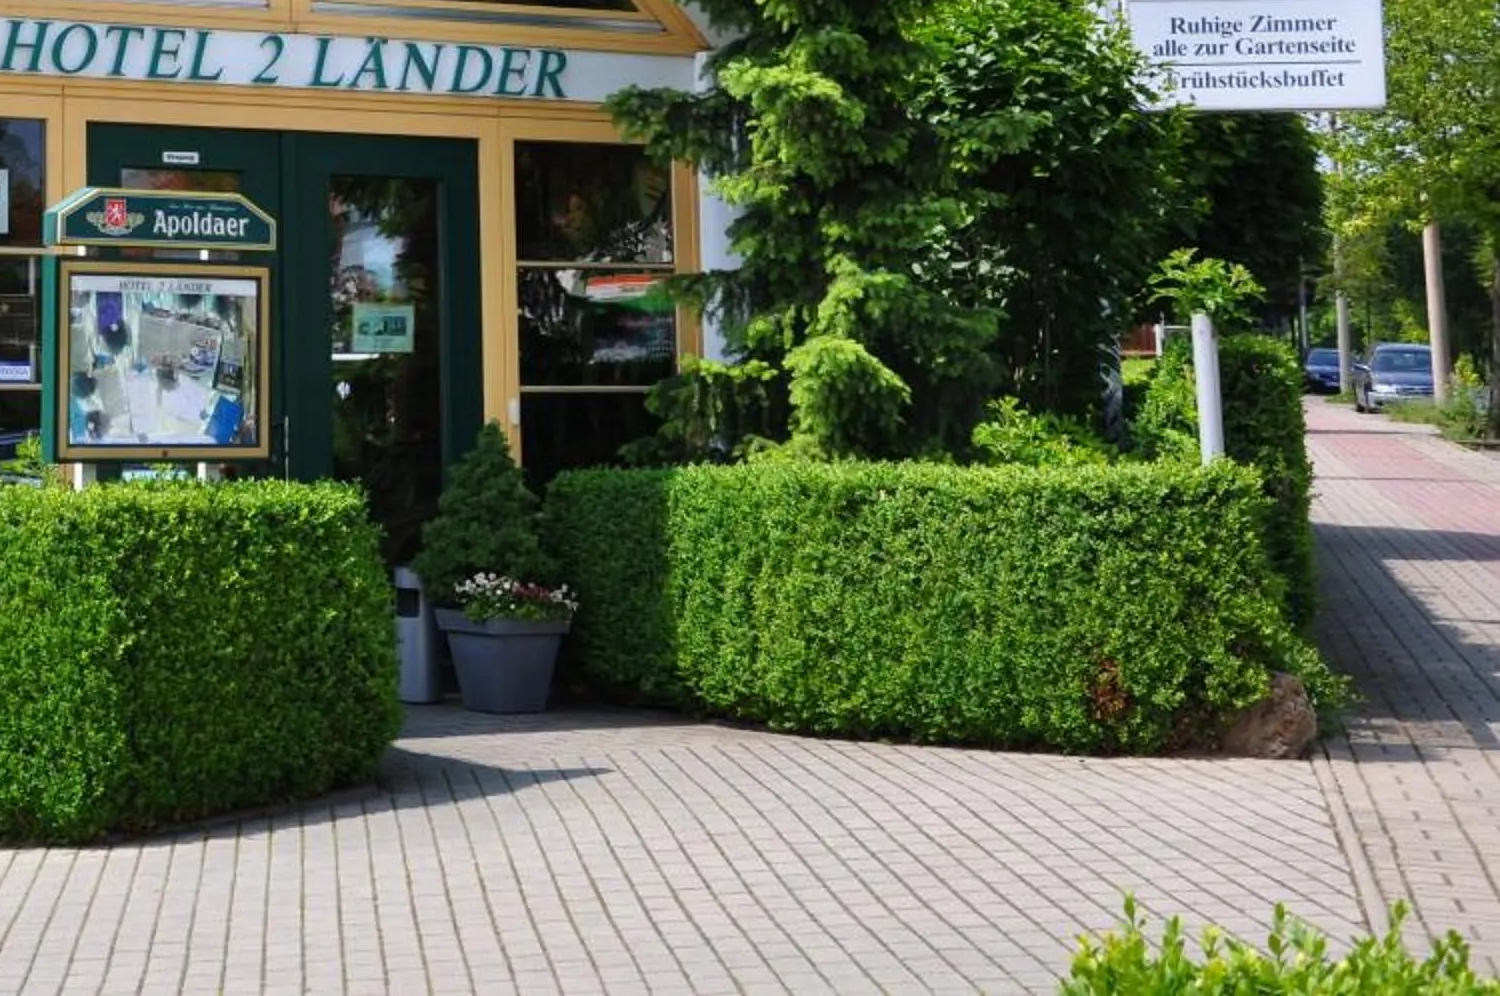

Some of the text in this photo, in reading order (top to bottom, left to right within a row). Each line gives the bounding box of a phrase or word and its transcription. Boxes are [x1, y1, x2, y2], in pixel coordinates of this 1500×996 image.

[1171, 14, 1338, 38] Ruhige Zimmer
[1153, 36, 1357, 57] alle zur Gartenseite
[252, 35, 285, 84] 2
[311, 37, 569, 99] LÄNDER
[153, 209, 251, 237] Apoldaer
